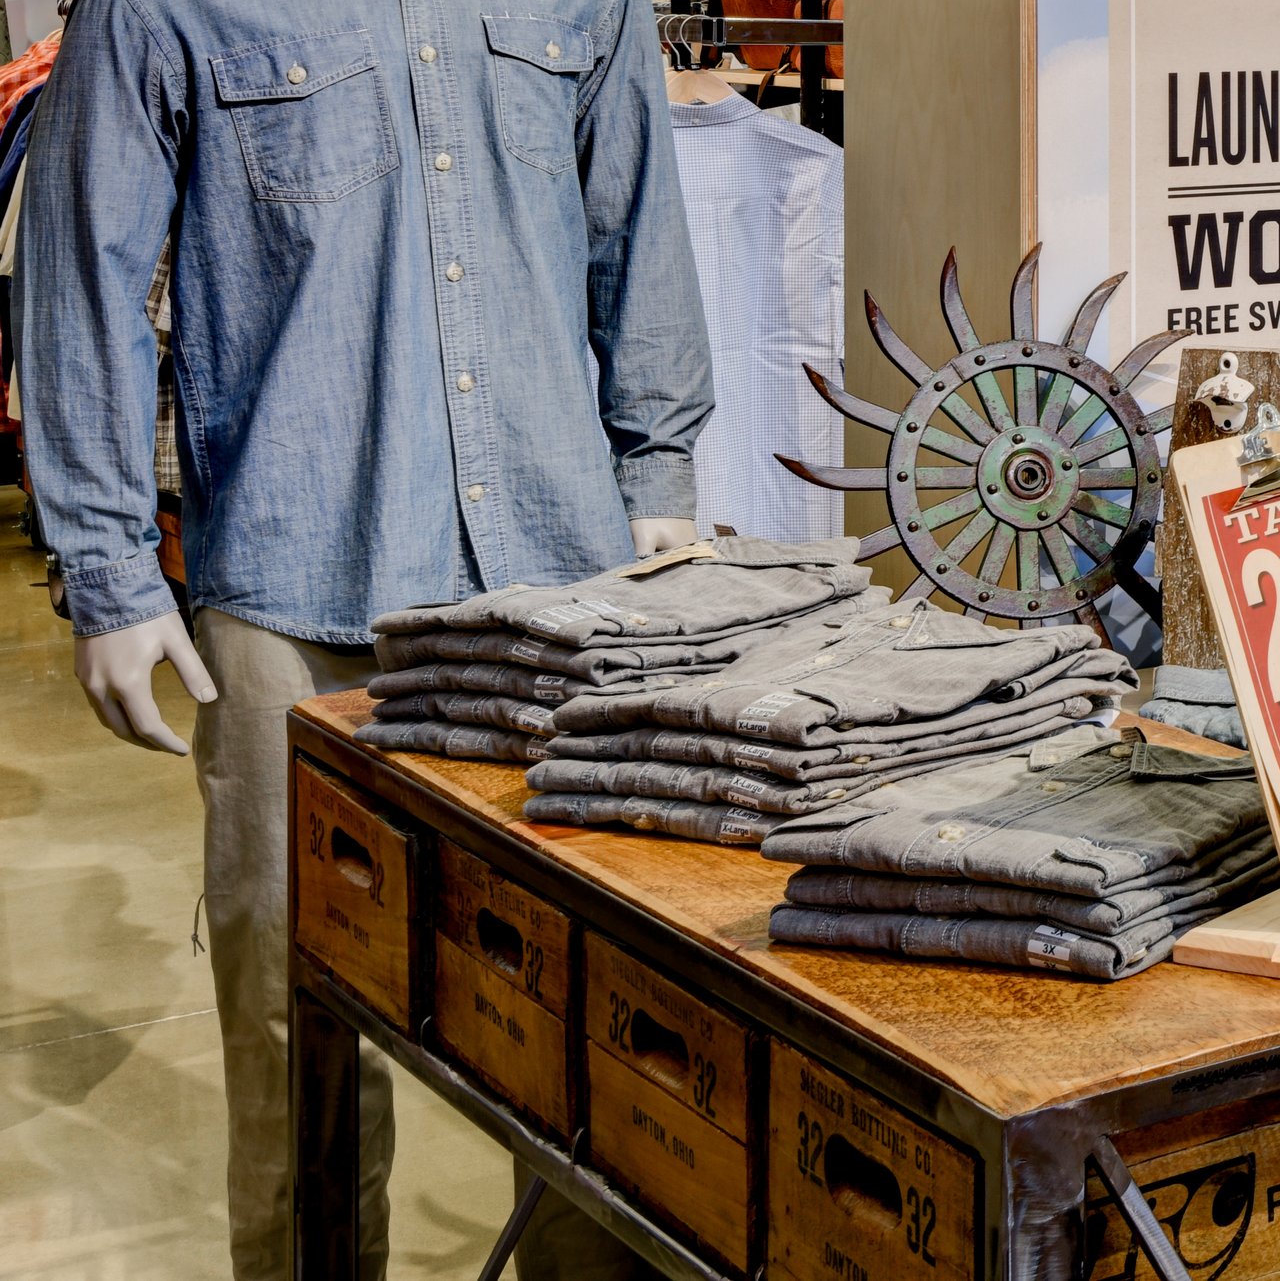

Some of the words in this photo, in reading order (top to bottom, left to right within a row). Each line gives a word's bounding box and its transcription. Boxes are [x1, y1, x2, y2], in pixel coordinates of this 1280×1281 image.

[1168, 304, 1240, 336] FREE
[530, 618, 557, 634] Medium
[514, 644, 538, 660] Medium
[541, 675, 561, 685] Large
[540, 690, 559, 699] Large
[522, 718, 542, 730] Large
[738, 722, 767, 733] X-Large
[528, 748, 553, 760] X-Larg
[741, 746, 770, 757] X-Large
[734, 778, 763, 793] X-Large
[730, 808, 760, 820] X-Large
[310, 812, 325, 863] 32
[722, 824, 750, 836] X-Large
[1042, 944, 1057, 956] 3X
[525, 940, 544, 1001] 32
[507, 1016, 526, 1048] OHIO
[609, 990, 630, 1054] 32
[693, 1052, 717, 1118] 32
[800, 1068, 844, 1119] SIEGLER
[851, 1103, 908, 1160] BOTTLING
[915, 1144, 936, 1180] CO.
[673, 1137, 695, 1170] OHIO
[797, 1110, 824, 1188] 32
[906, 1186, 937, 1268] 32
